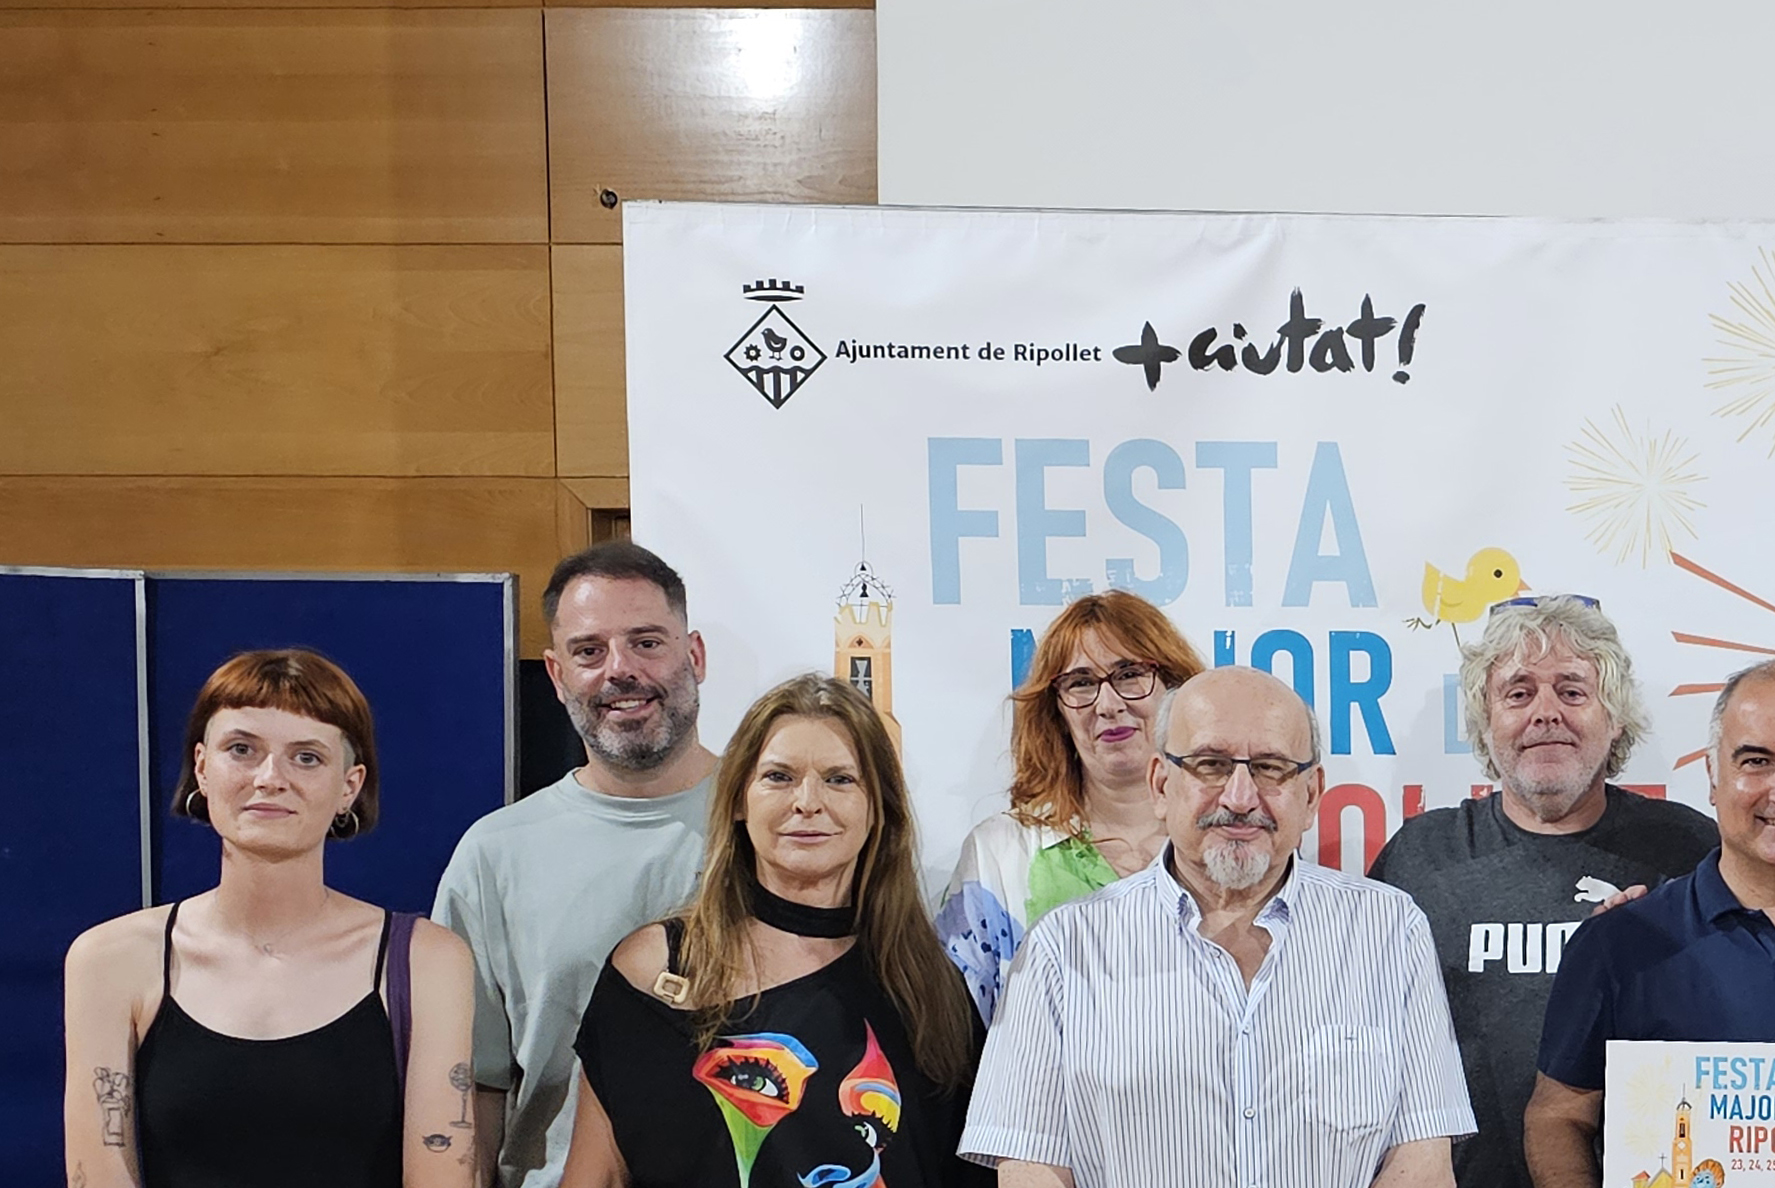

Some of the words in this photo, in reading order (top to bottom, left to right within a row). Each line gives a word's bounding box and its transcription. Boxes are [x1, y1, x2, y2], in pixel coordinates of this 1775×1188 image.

[835, 339, 970, 363] Ajuntament
[978, 342, 1005, 361] de
[1014, 342, 1102, 366] Ripollet
[927, 437, 1379, 608] FESTA
[1731, 1159, 1746, 1172] 23,
[1749, 1159, 1764, 1172] 24,
